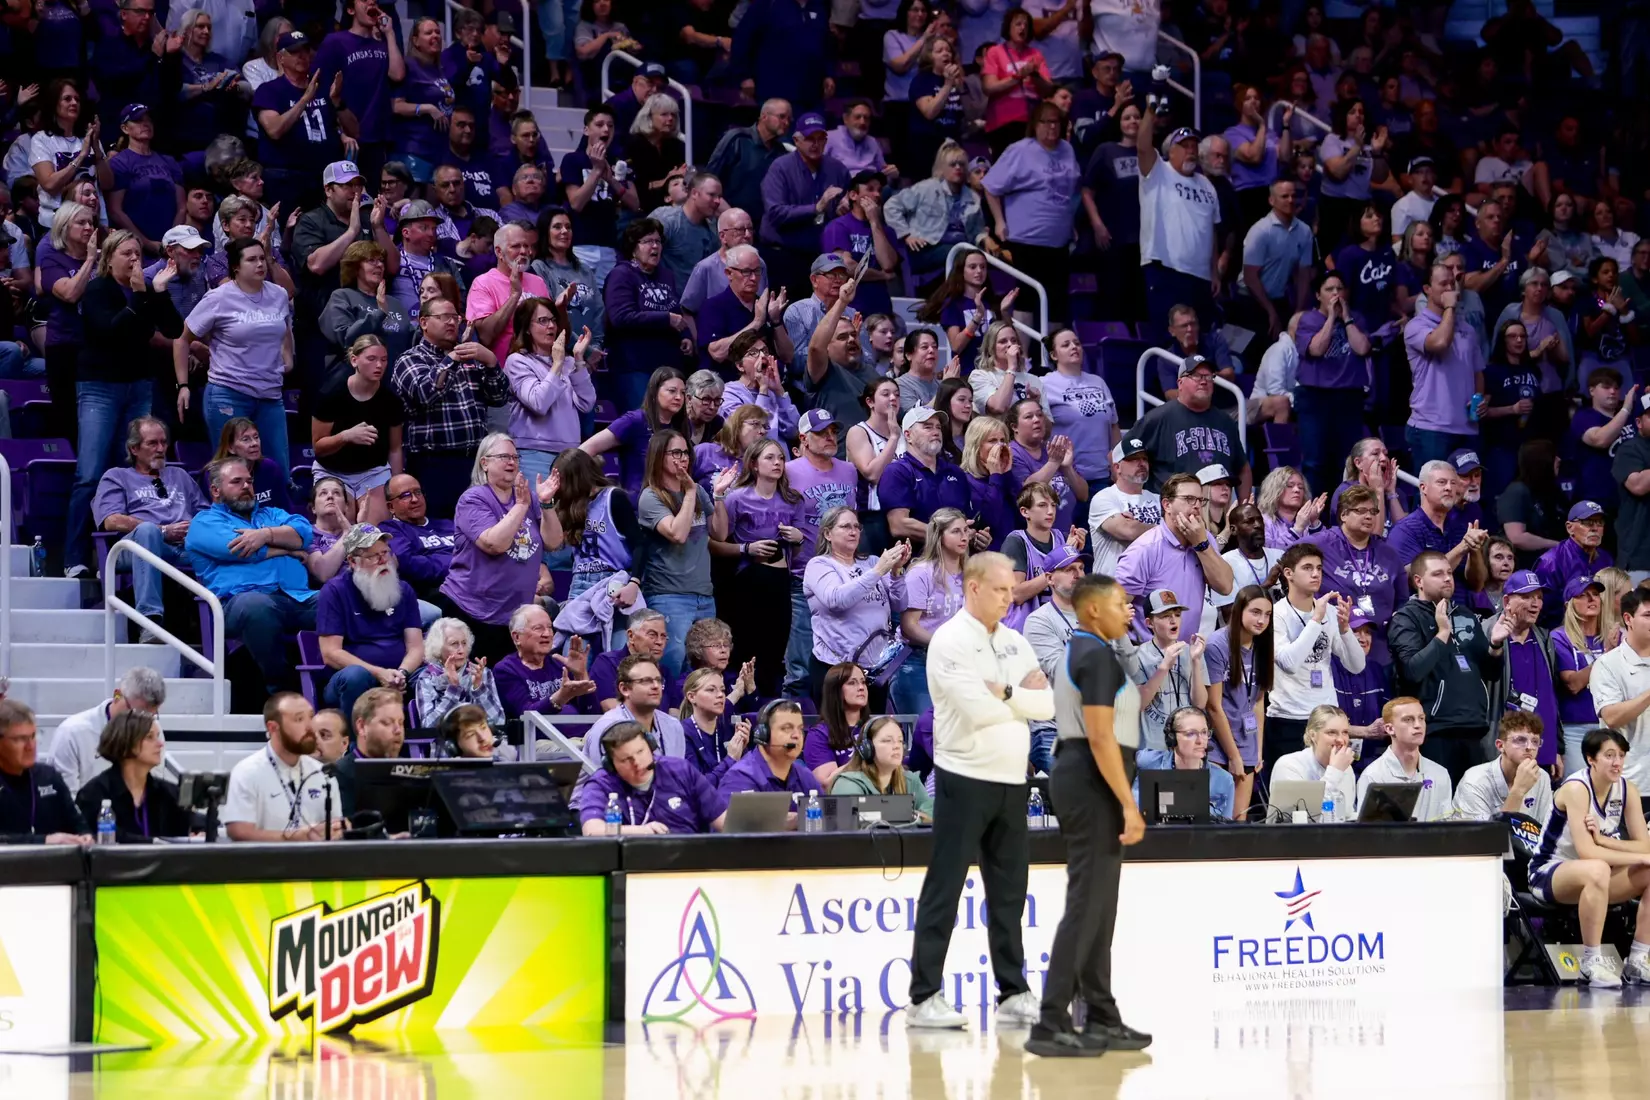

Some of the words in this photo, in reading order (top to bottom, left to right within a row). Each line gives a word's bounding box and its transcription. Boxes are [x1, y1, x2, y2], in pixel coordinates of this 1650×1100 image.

[347, 51, 373, 66] KANSAS
[300, 108, 327, 141] 11
[1359, 258, 1392, 284] Cats
[1175, 426, 1231, 458] K-STATE
[804, 485, 822, 500] EAT
[585, 519, 607, 533] SAS
[1213, 931, 1385, 969] FREEDOM
[778, 959, 865, 1014] Via
[1213, 971, 1278, 983] BEHAVIORAL
[1282, 967, 1325, 979] HEALTH
[1328, 964, 1386, 977] SOLUTIONS
